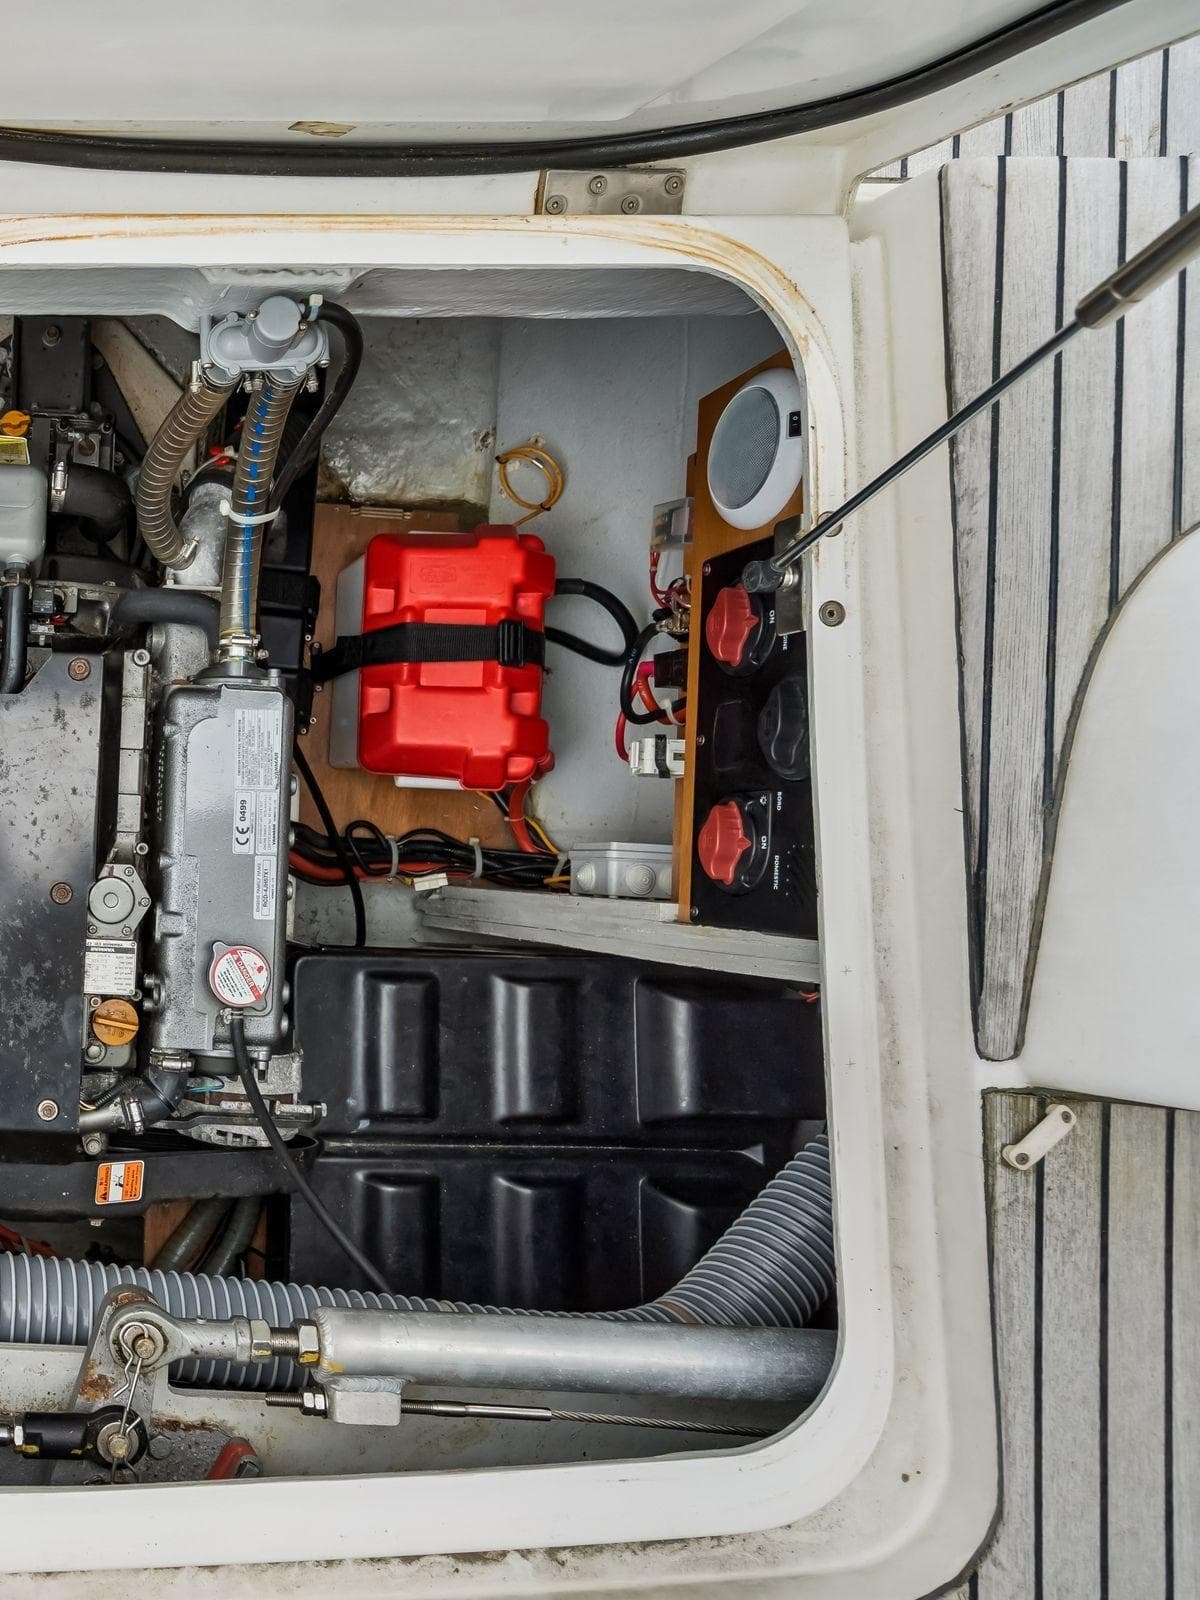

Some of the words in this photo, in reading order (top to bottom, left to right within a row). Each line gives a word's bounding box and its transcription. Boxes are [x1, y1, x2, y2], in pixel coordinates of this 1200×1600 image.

[768, 609, 775, 624] ON
[239, 799, 247, 822] 0499
[235, 826, 250, 846] CE
[761, 835, 767, 850] ON
[237, 961, 254, 987] DANGER
